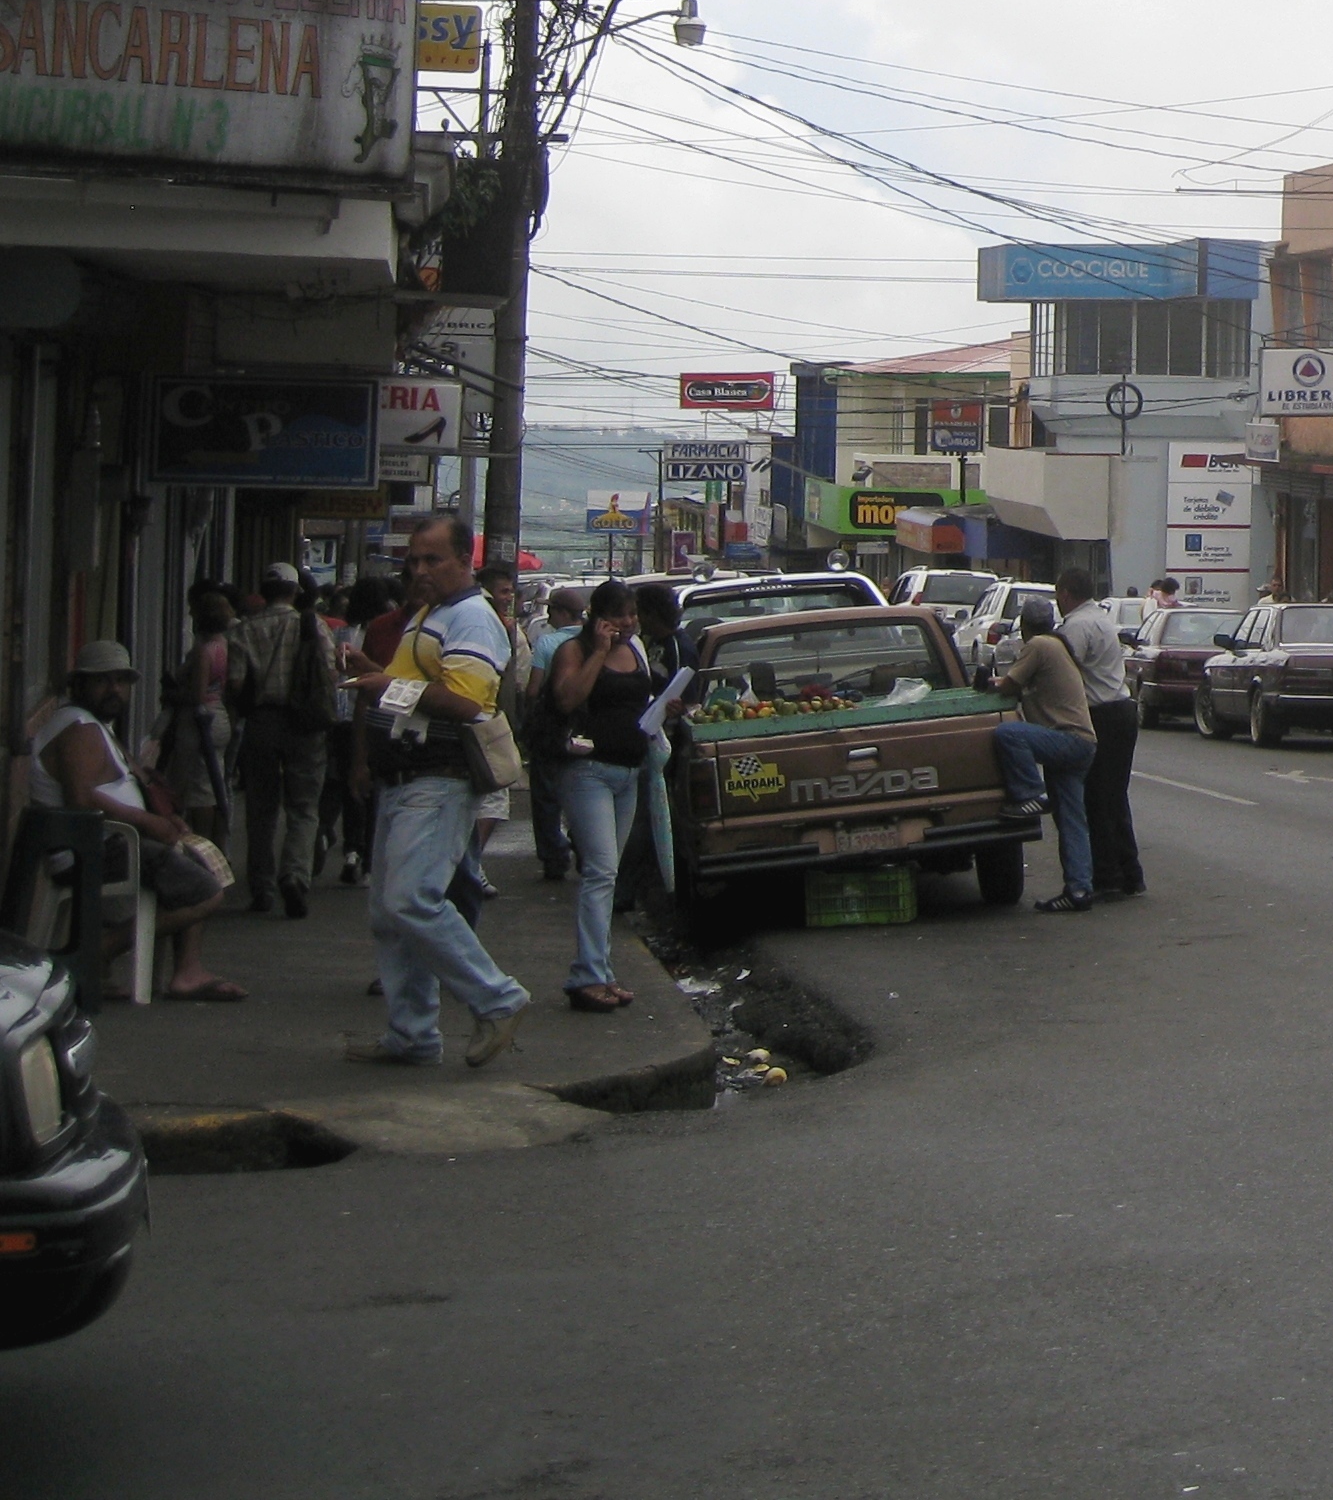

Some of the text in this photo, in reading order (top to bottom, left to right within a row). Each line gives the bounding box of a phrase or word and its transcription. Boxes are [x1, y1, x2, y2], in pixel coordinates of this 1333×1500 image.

[1037, 259, 1149, 278] COOCIQUE
[688, 387, 748, 397] Casa Blanca
[1282, 402, 1290, 410] EL
[672, 443, 740, 458] FARMACIA
[667, 464, 743, 480] LIZANO
[1194, 504, 1220, 513] débito
[1193, 512, 1219, 520] crédito
[592, 518, 636, 529] GOLLO
[727, 776, 783, 791] BARDAHL
[790, 766, 939, 803] mazda
